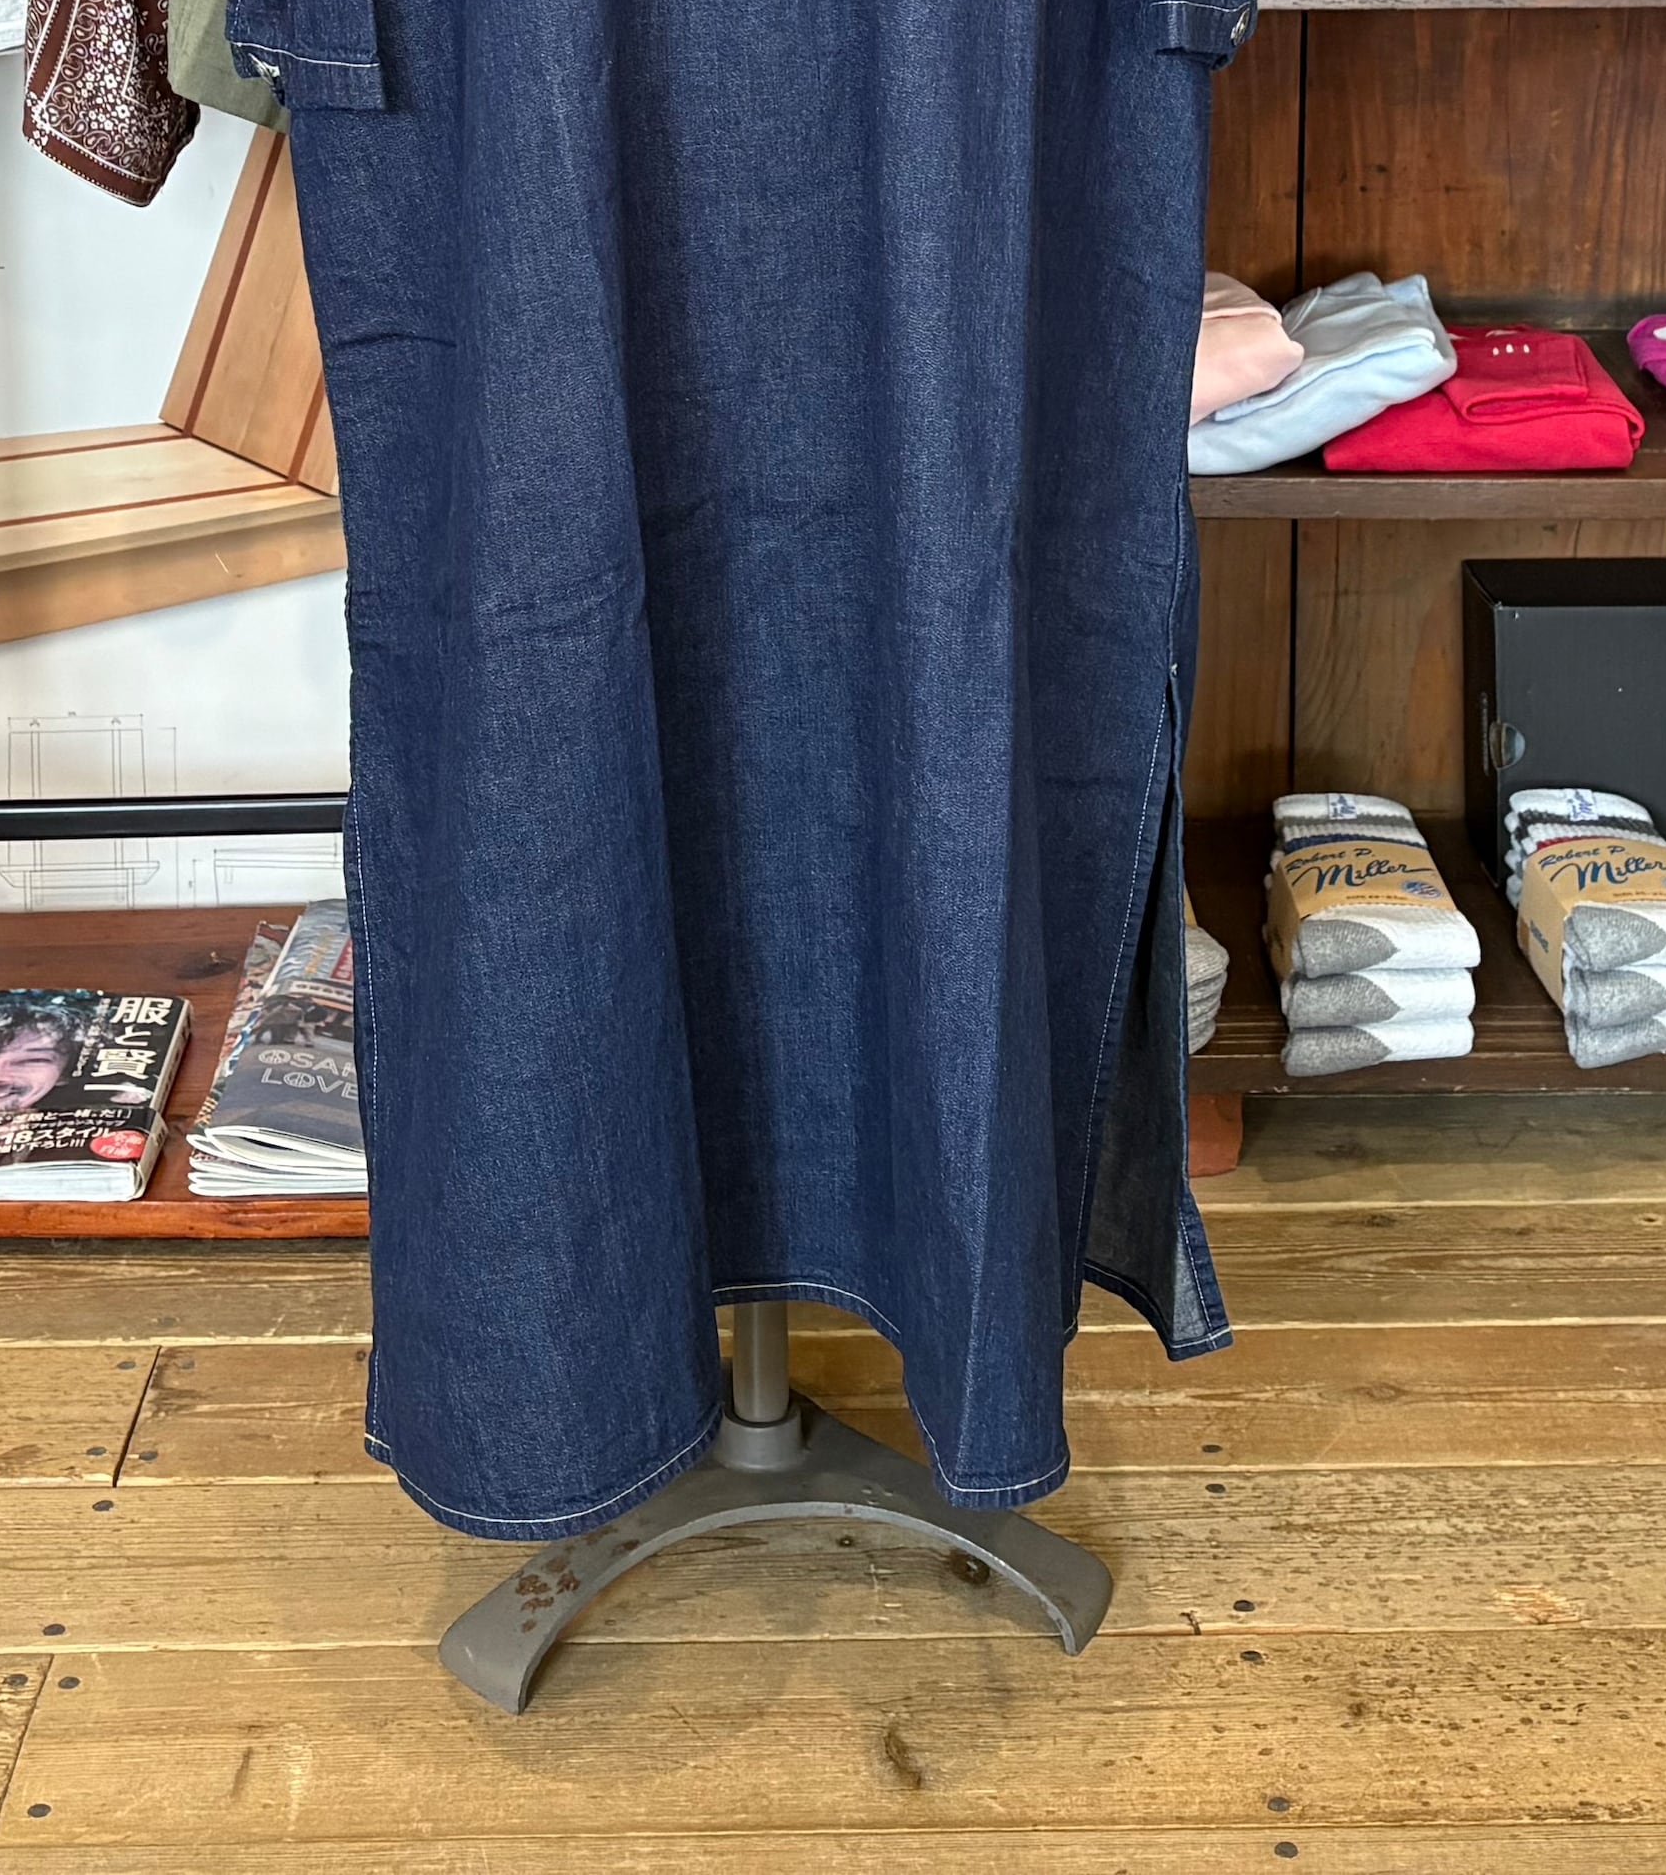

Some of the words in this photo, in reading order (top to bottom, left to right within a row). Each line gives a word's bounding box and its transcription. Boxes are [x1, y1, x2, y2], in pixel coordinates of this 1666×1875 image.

[1291, 860, 1433, 894] Miller
[83, 996, 174, 1092] 服と賢一
[258, 1049, 358, 1077] OSAK
